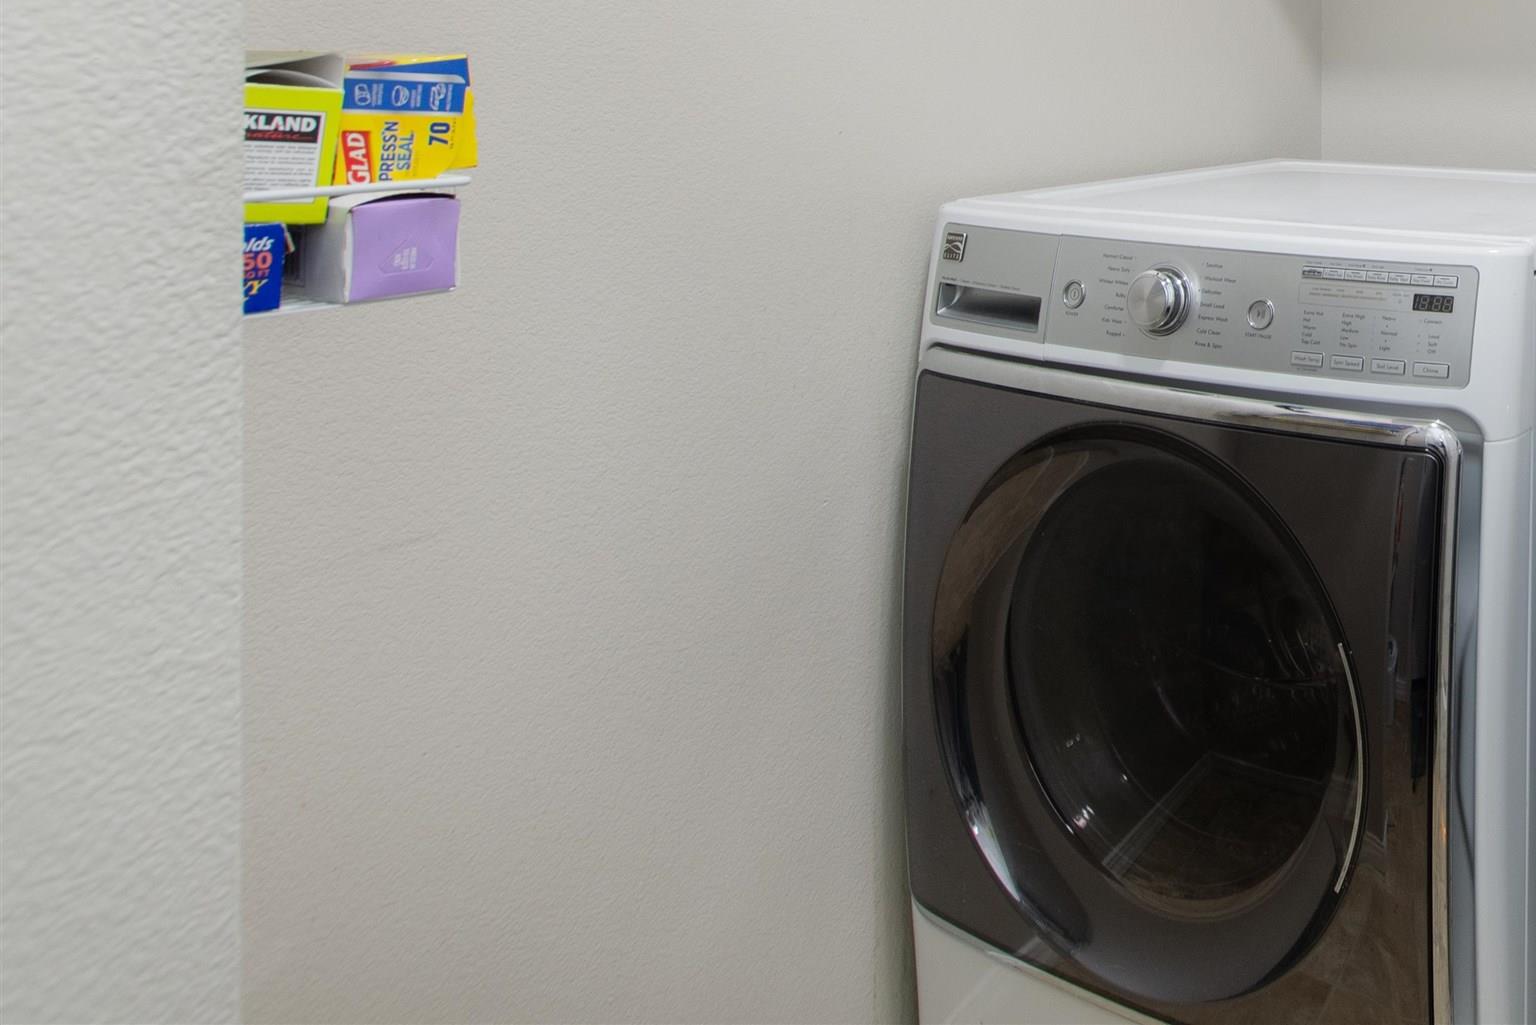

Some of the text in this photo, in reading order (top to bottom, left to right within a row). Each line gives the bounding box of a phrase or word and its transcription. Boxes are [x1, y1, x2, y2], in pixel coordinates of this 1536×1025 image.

[245, 114, 318, 133] KLAND
[428, 122, 451, 145] 70
[347, 132, 371, 186] GLAD
[396, 134, 414, 171] SEAL
